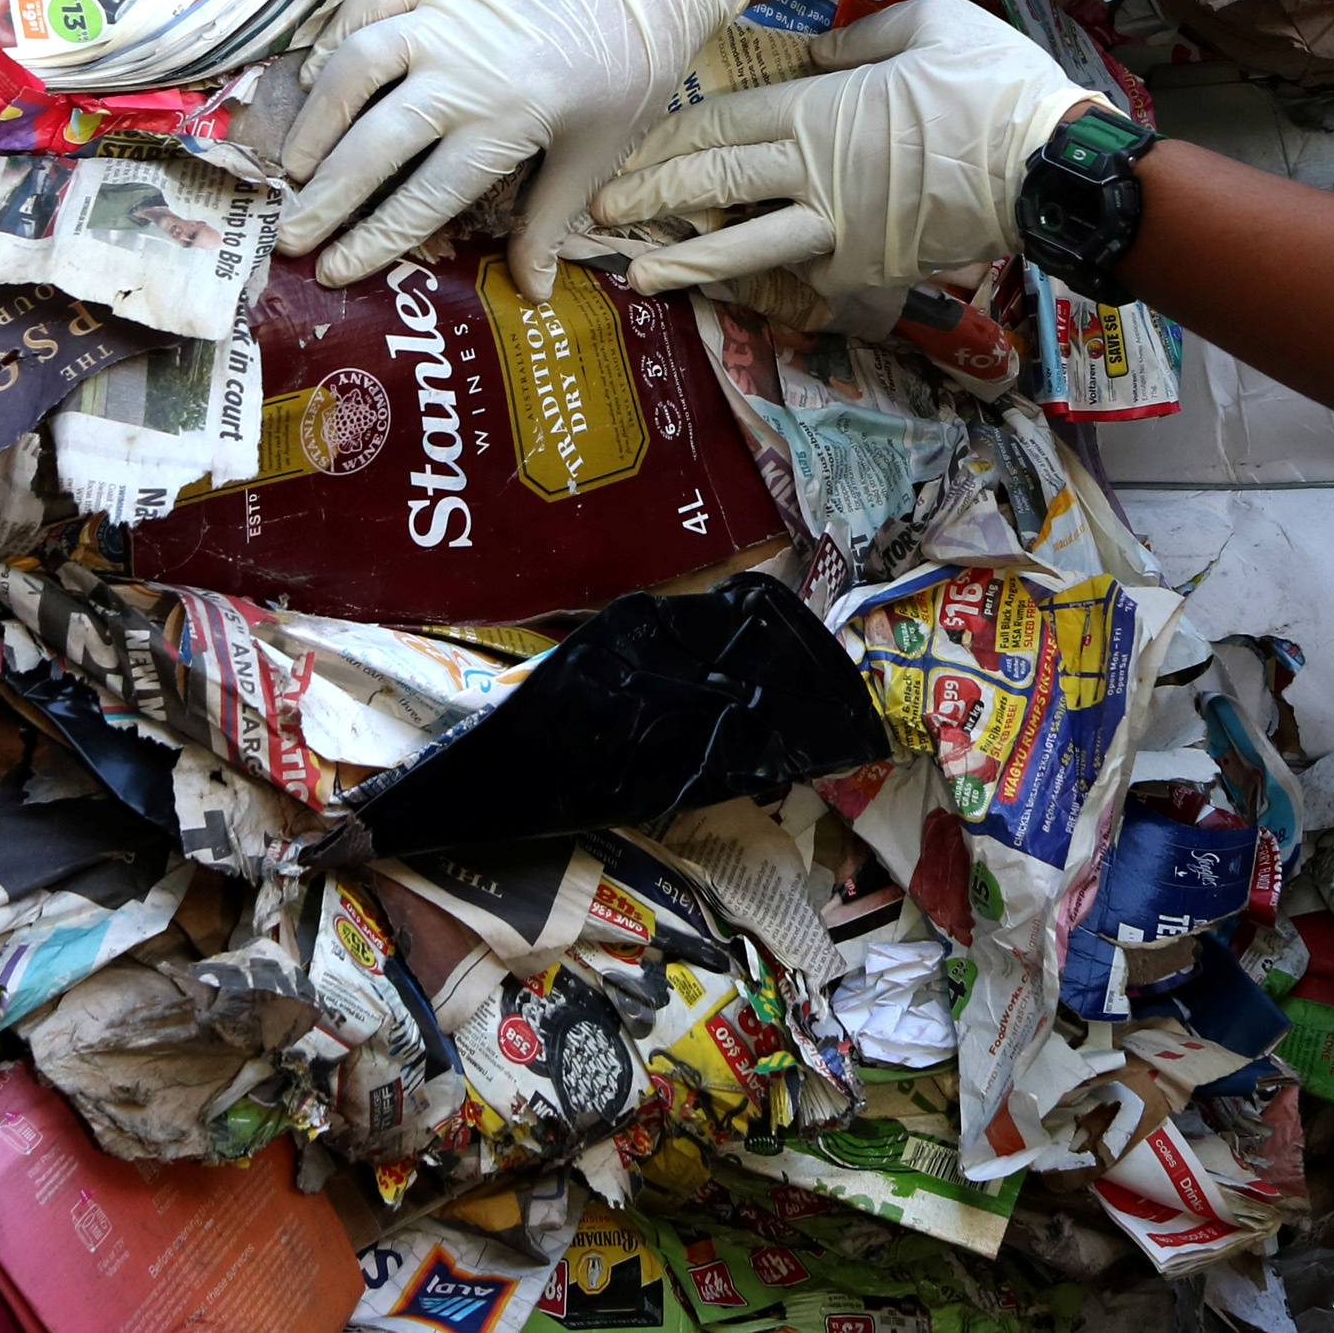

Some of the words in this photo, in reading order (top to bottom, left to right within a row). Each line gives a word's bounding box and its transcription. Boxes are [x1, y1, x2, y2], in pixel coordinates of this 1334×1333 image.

[229, 197, 254, 230] trip
[223, 229, 244, 249] to
[215, 248, 244, 281] Bris
[535, 301, 572, 360] RED
[1104, 314, 1119, 332] $6
[58, 343, 115, 382] THE
[229, 352, 249, 374] in
[1108, 333, 1123, 365] SAVE
[453, 323, 492, 456] WINES
[510, 331, 536, 422] AUSTRALIAN
[1089, 363, 1098, 406] Voltaren
[218, 375, 245, 443] court
[335, 370, 391, 435] COMPANY
[384, 259, 475, 549] Stanley
[561, 377, 588, 436] DRY
[302, 390, 331, 468] STANLEY
[341, 433, 384, 475] WINE
[677, 487, 710, 536] 4L
[984, 598, 996, 617] per
[988, 583, 1000, 598] kg
[1007, 576, 1018, 607] Angus
[1001, 606, 1014, 630] Black
[1016, 599, 1027, 629] Rumps
[1000, 629, 1009, 650] Full
[1012, 629, 1021, 650] MSA
[232, 642, 256, 696] AND
[1003, 745, 1028, 799] WAGYU
[1021, 698, 1043, 745] RUMPS
[1013, 805, 1033, 848] CHICKEN
[714, 1026, 739, 1057] $60
[733, 1050, 769, 1105] SAVE
[1153, 1138, 1178, 1169] coles
[1178, 1178, 1208, 1214] Drinks
[424, 1273, 497, 1299] ALDI
